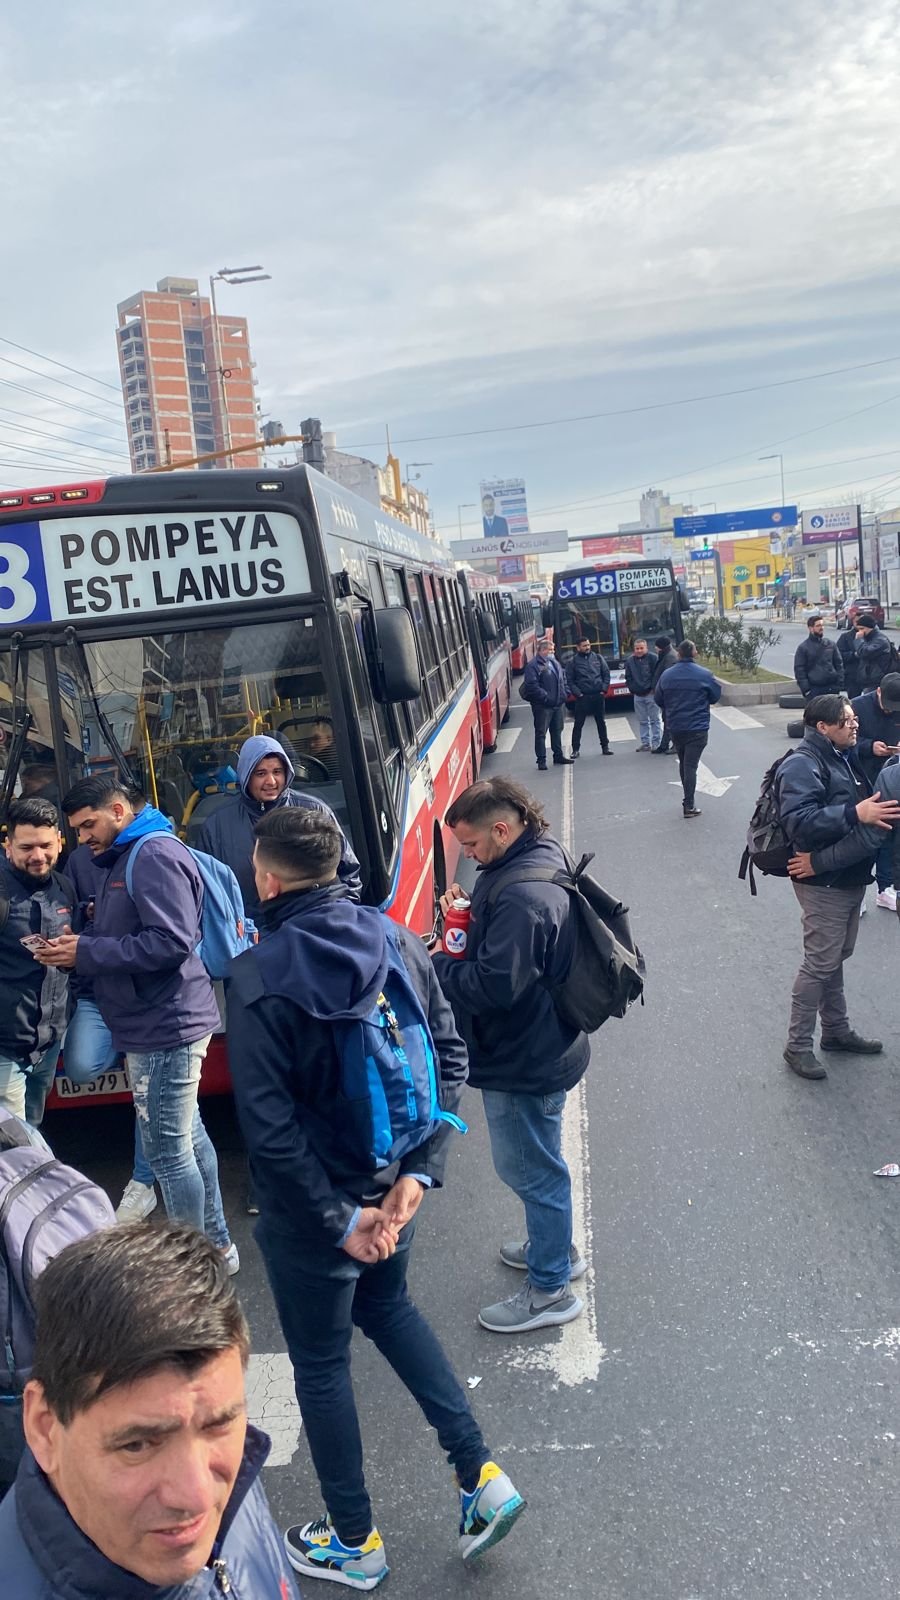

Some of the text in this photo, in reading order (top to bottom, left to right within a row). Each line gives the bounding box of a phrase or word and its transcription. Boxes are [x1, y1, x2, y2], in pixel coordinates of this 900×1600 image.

[60, 514, 278, 569] POMPEYA
[696, 551, 713, 559] YPF
[619, 568, 665, 580] POMPEYA
[64, 558, 285, 614] EST. LANUS
[570, 575, 615, 597] 158
[619, 578, 667, 591] EST. LANUS
